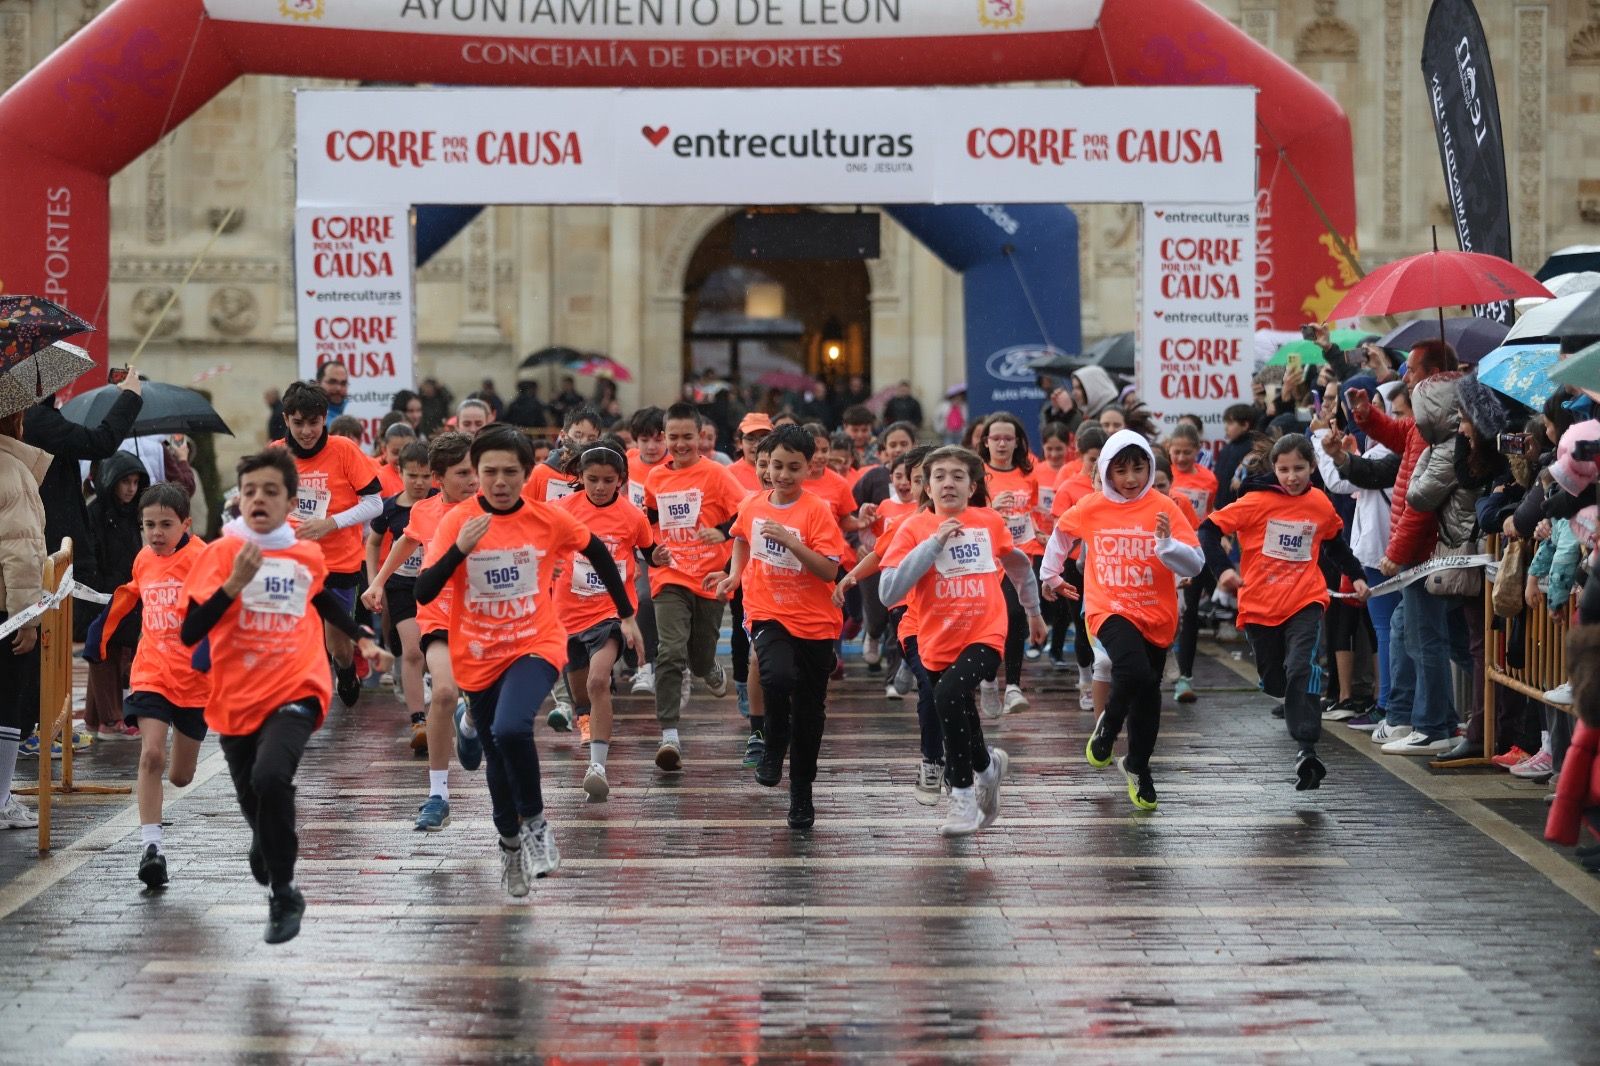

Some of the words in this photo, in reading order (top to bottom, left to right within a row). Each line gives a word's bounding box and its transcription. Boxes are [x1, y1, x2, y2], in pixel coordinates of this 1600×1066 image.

[400, 0, 719, 26] AYUNTAMIENTO
[735, 0, 783, 26] DE
[460, 40, 638, 69] CONCEJALÍA
[648, 46, 687, 69] DE
[697, 44, 844, 69] DEPORTES
[325, 129, 438, 168] CORRE
[442, 136, 468, 151] POR
[475, 130, 583, 167] CAUSA
[672, 128, 915, 159] entreculturas
[965, 126, 1078, 166] CORRE
[1083, 133, 1109, 149] POR
[1116, 128, 1224, 164] CAUSA
[443, 150, 469, 164] UNA
[845, 162, 869, 174] ONG
[872, 162, 914, 174] JESUITA
[1084, 149, 1110, 162] UNA
[311, 215, 395, 245] CORRE
[1164, 211, 1251, 224] entreculturas
[44, 185, 72, 309] EPORTES
[1160, 237, 1244, 267] CORRE
[313, 251, 394, 279] CAUSA
[1160, 262, 1181, 273] POR
[1183, 262, 1202, 272] UNA
[316, 290, 403, 303] entreculturas
[1160, 273, 1241, 300] CAUSA
[1163, 310, 1250, 324] entreculturas
[314, 316, 398, 345] CORRE
[1159, 337, 1242, 367] CORRE
[1160, 362, 1180, 374] POR
[1182, 362, 1201, 372] UNA
[1160, 373, 1240, 400] CAUSA
[668, 503, 691, 517] 1558
[948, 543, 981, 561] 1535
[1093, 535, 1157, 561] CORRE
[484, 565, 520, 585] 1505
[1096, 563, 1154, 588] CAUSA
[934, 578, 987, 600] CAUSA
